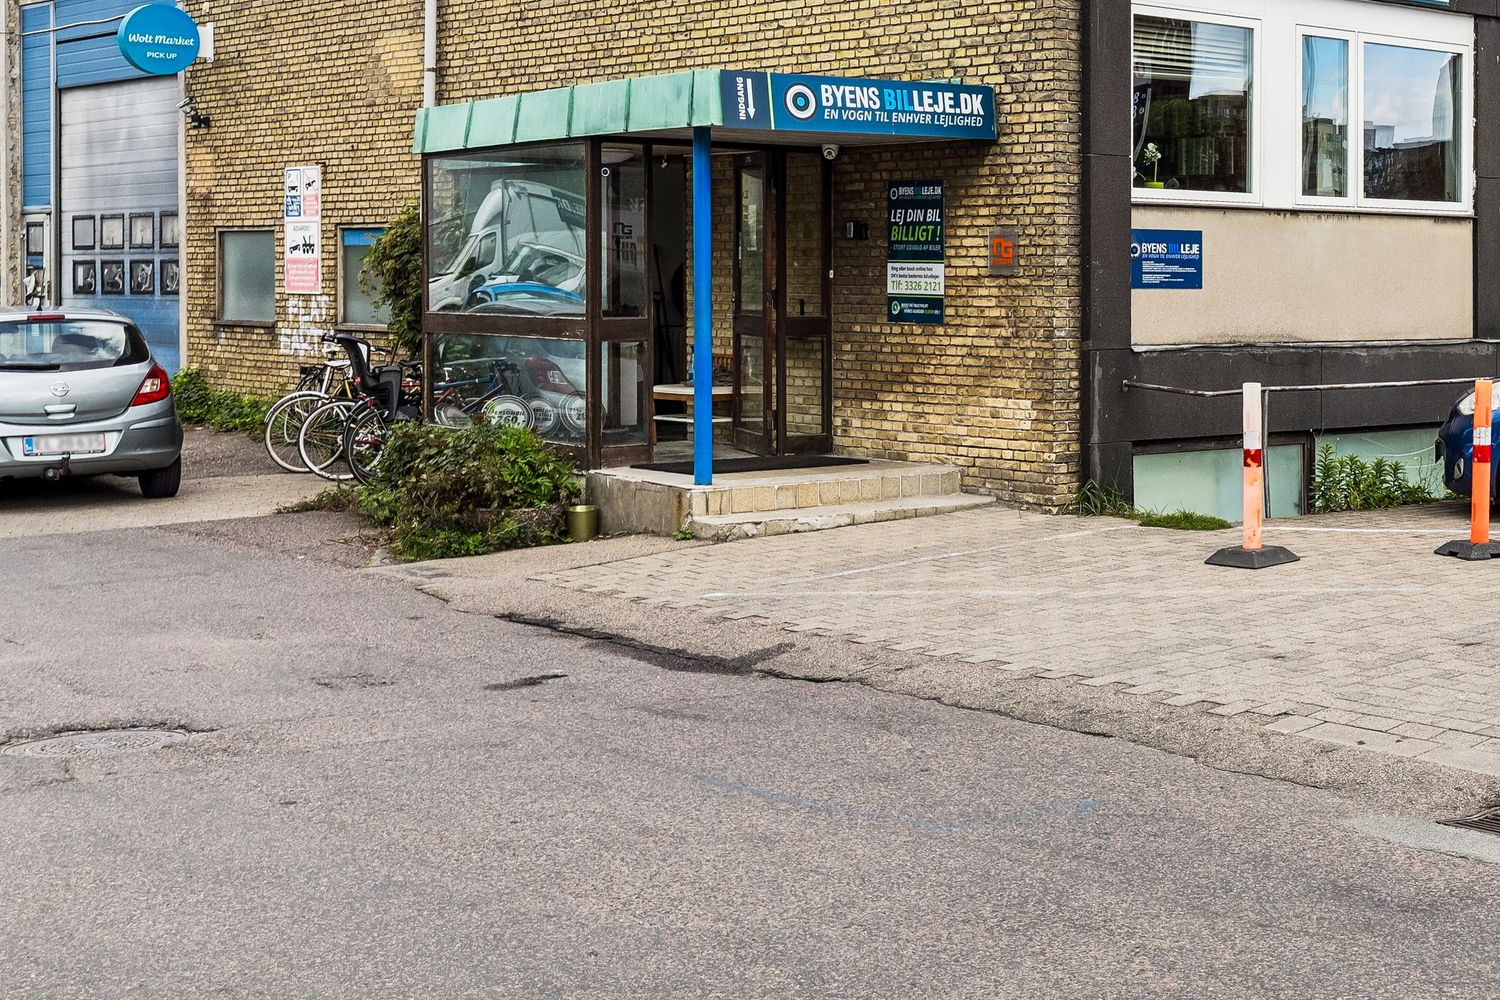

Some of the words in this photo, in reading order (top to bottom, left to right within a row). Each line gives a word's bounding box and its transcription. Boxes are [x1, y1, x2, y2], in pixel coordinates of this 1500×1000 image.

[128, 33, 153, 43] Wolt
[154, 35, 195, 46] Market
[146, 51, 165, 59] PICK
[820, 84, 880, 110] BYENS
[884, 88, 985, 115] BILLEJE.DK
[824, 108, 839, 119] EN
[841, 109, 873, 122] VOGN
[875, 111, 890, 123] TIL
[892, 112, 932, 125] ENHVER
[934, 114, 983, 128] LEJLIGHED
[891, 209, 905, 225] LEJ
[907, 209, 924, 222] DIN
[926, 209, 941, 222] BIL
[891, 225, 934, 241] BILLIGT
[1141, 242, 1167, 254] BYENS
[1168, 243, 1200, 254] BILLEJE
[892, 280, 903, 290] Tlf:
[905, 280, 922, 290] 3326
[924, 281, 941, 291] 2121
